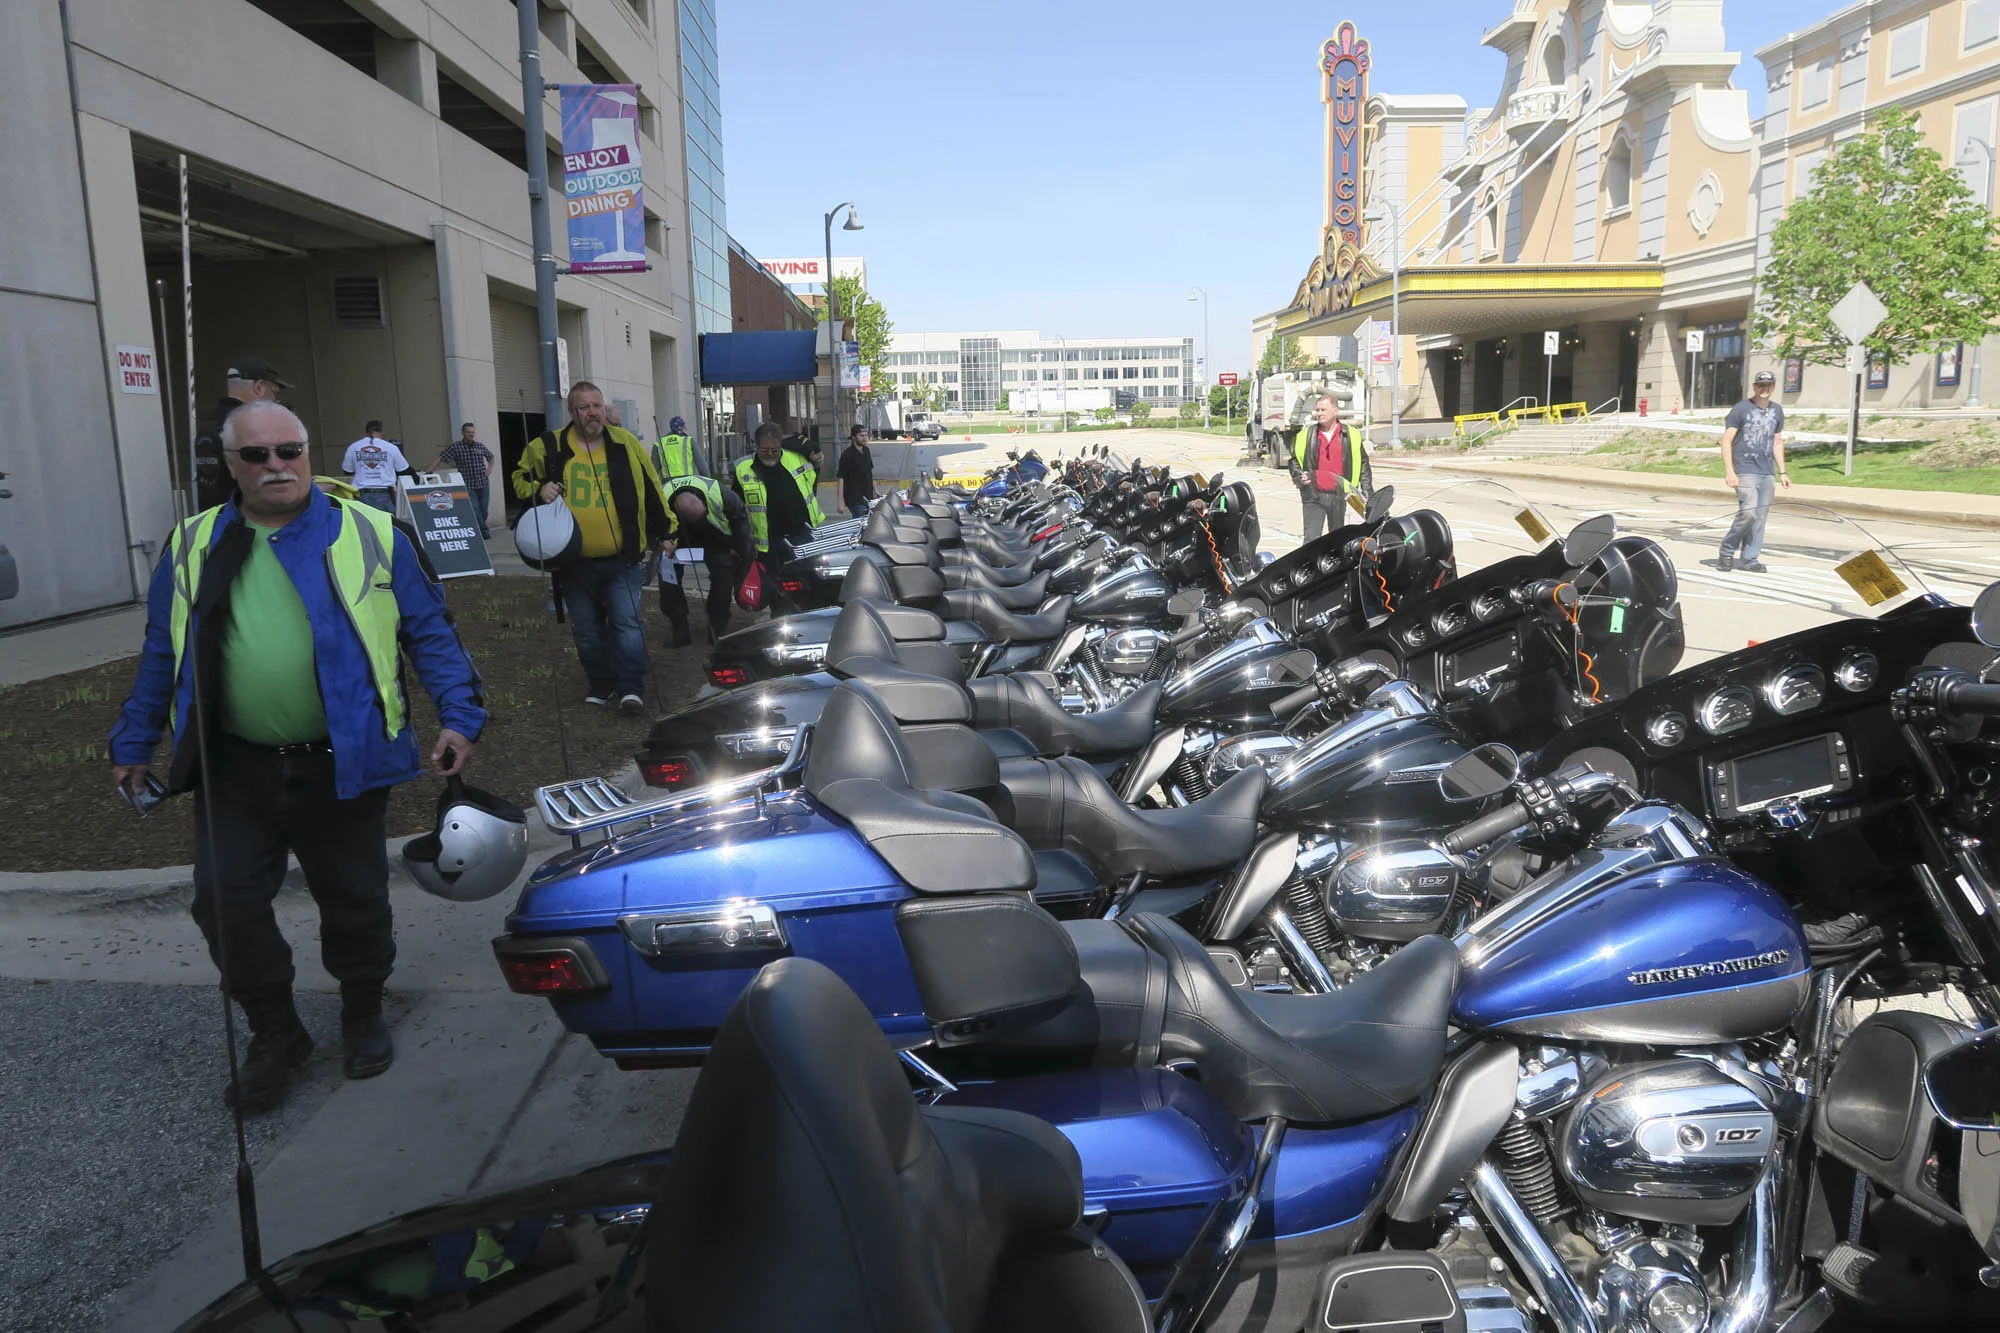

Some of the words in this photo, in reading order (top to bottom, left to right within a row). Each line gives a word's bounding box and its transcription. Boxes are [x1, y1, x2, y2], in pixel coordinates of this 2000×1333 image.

[1335, 75, 1357, 226] MUVICO
[564, 147, 621, 172] ENJOY
[565, 169, 641, 194] OUTDOOR
[567, 192, 630, 217] DINING
[118, 351, 132, 368] DO
[134, 352, 152, 369] NOT
[124, 371, 152, 388] ENTER
[433, 516, 460, 528] BIKE
[425, 527, 476, 541] RETURNS
[440, 539, 470, 552] HERE
[1418, 876, 1449, 886] 107
[1715, 1127, 1762, 1142] 107
